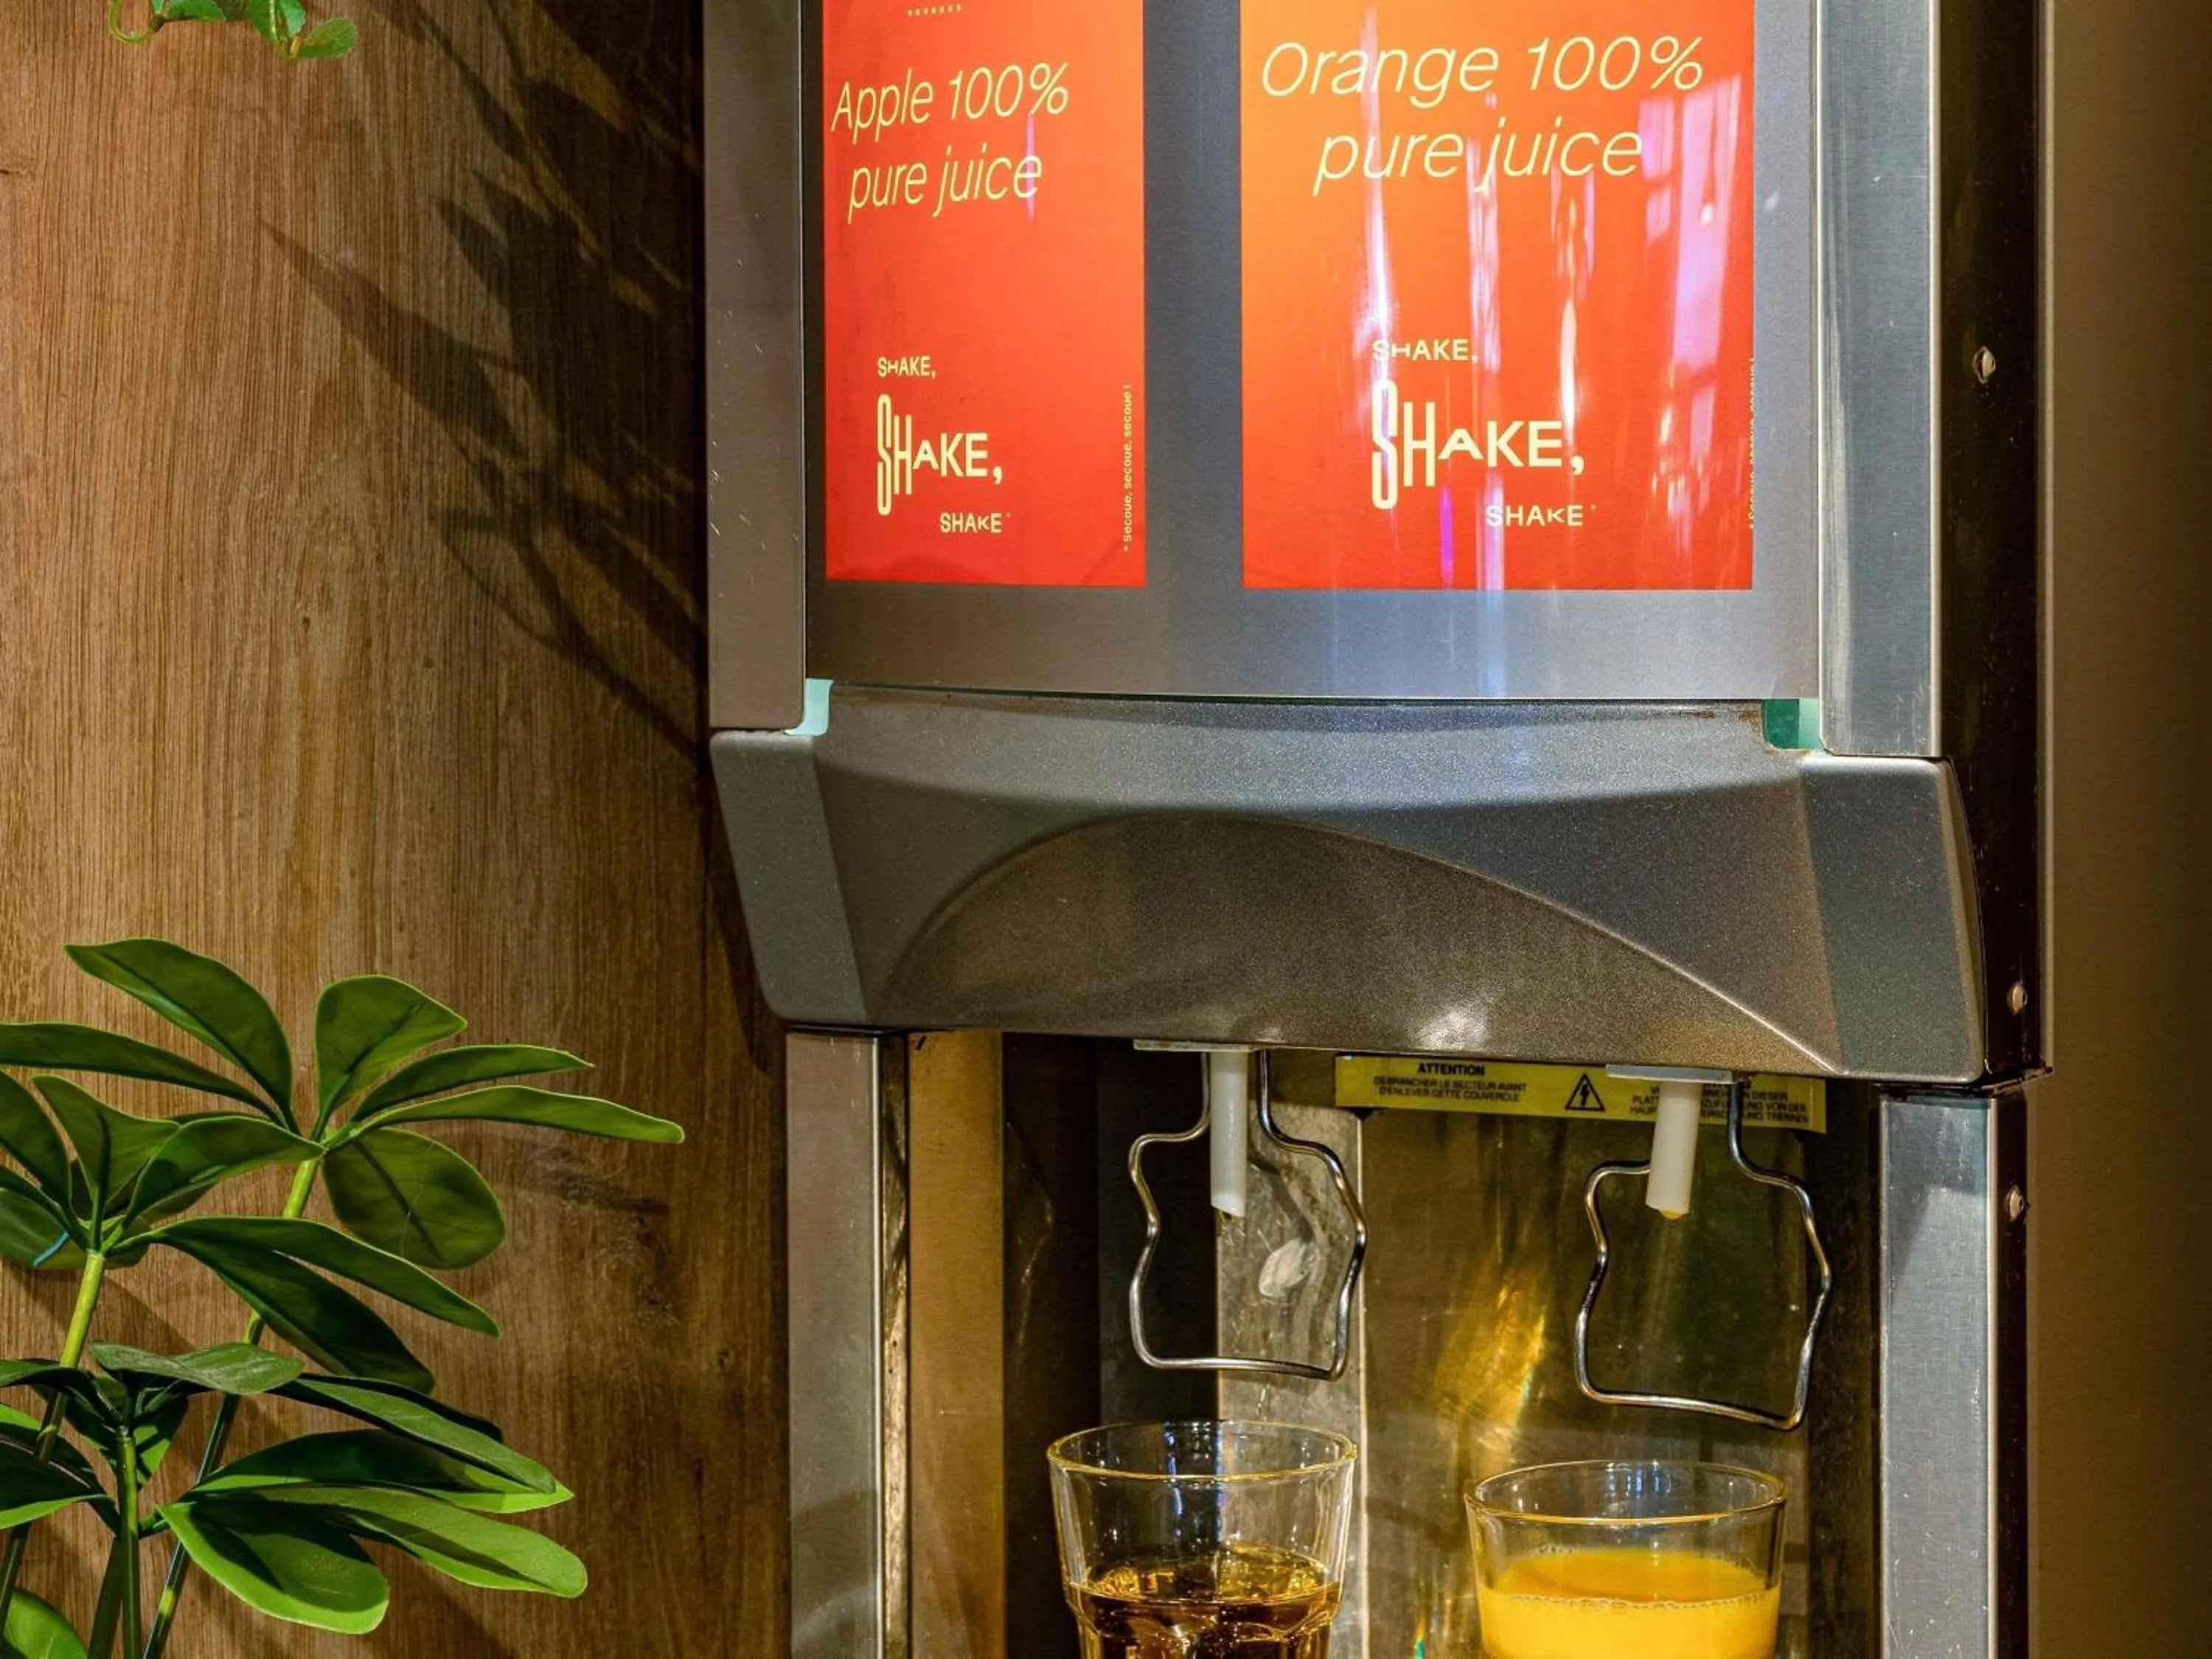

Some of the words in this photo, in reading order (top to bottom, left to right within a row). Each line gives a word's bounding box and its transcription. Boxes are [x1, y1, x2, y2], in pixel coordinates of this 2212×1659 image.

[831, 68, 934, 145] Apple
[949, 62, 1069, 119] 100%
[1262, 42, 1500, 108] Orange
[1527, 35, 1704, 92] 100%
[847, 162, 928, 225] pure
[932, 142, 1043, 218] juice
[1312, 132, 1465, 197] pure
[1474, 116, 1644, 194] juice
[877, 355, 936, 379] SHAKE,
[1371, 338, 1478, 364] SHAKE,
[877, 394, 1003, 517] SHAKE,
[1371, 378, 1585, 510] SHAKE,
[1379, 1085, 1430, 1097] D'ENLEVER
[1431, 1088, 1461, 1099] CETTE
[1463, 1091, 1520, 1102] COUVERCLE
[1417, 1062, 1485, 1077] ATTENTION
[1439, 1079, 1450, 1088] LE
[1453, 1080, 1496, 1091] SECTEUR
[1498, 1082, 1526, 1092] AVANT
